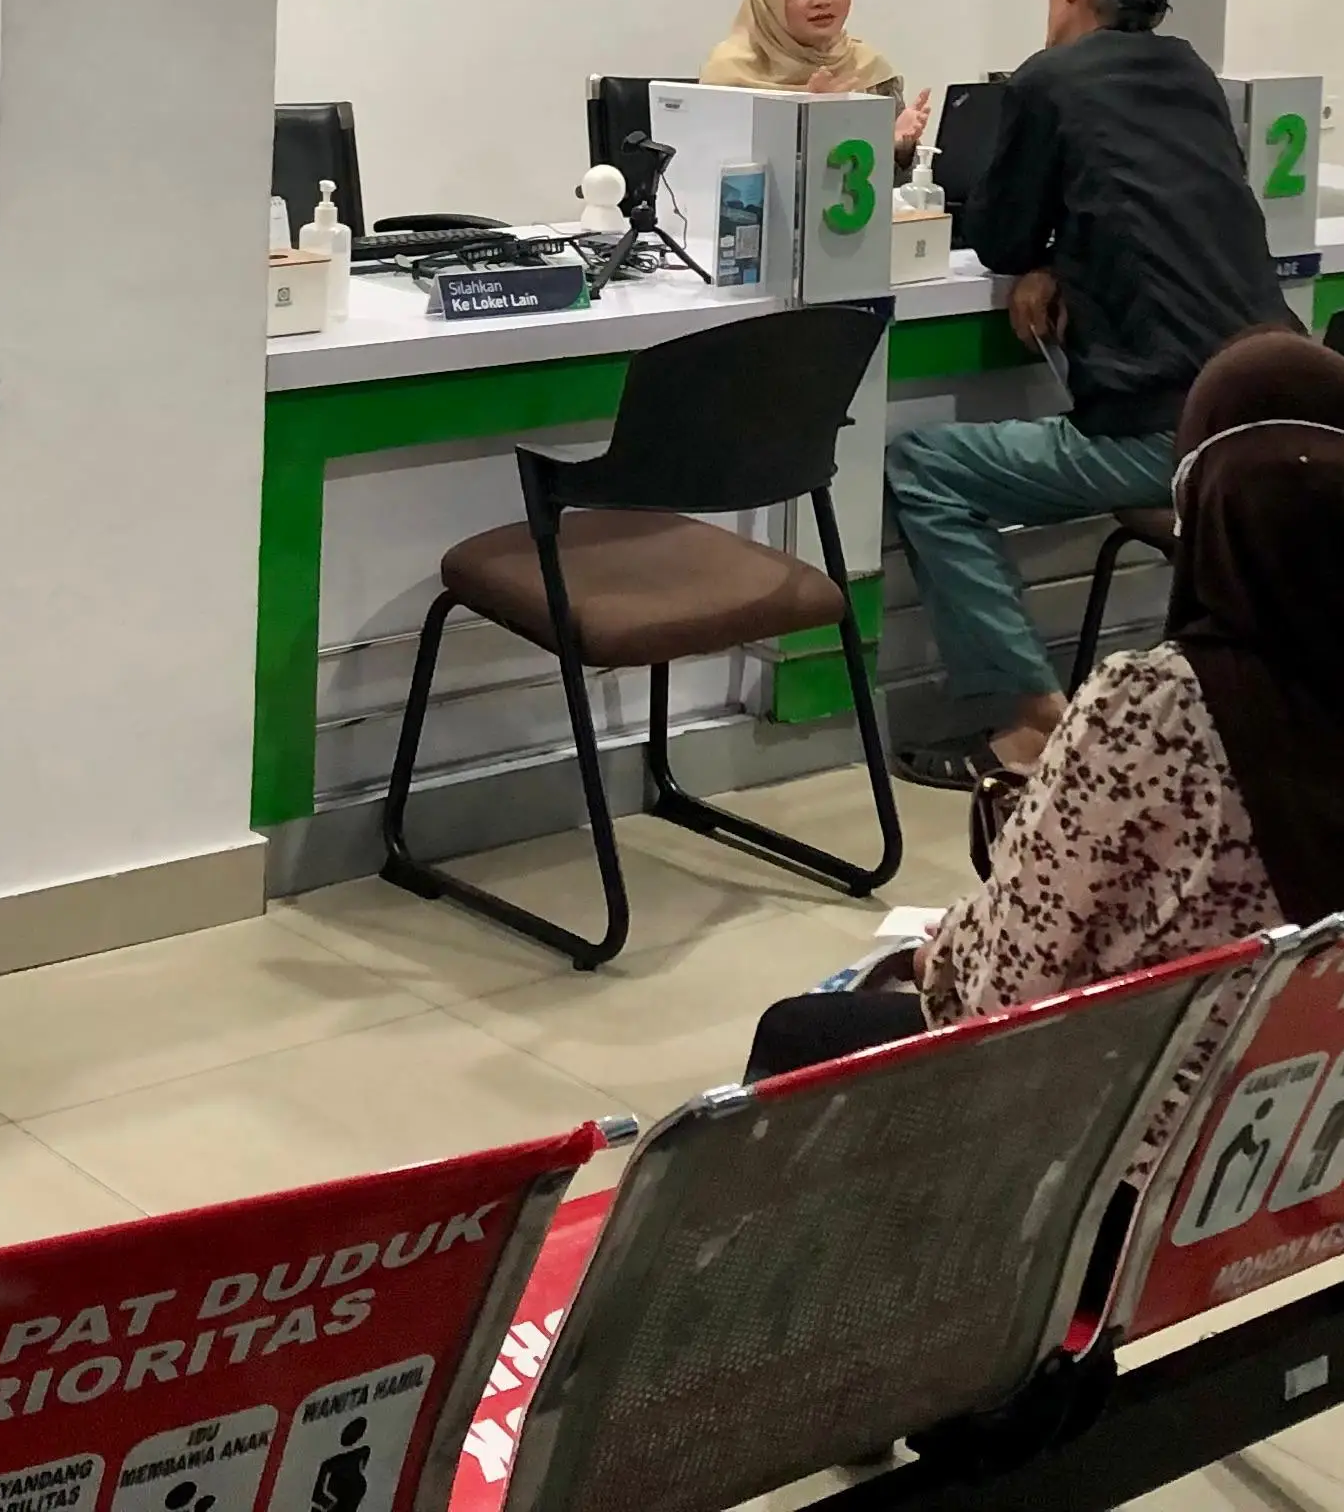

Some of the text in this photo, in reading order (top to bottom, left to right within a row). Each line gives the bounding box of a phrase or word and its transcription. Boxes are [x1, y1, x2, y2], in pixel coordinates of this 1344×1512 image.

[822, 139, 875, 235] 3
[1263, 113, 1308, 199] 2
[448, 279, 503, 296] Silahkan
[452, 292, 538, 312] Ke Loket Lain
[197, 1199, 501, 1321] DUDUK
